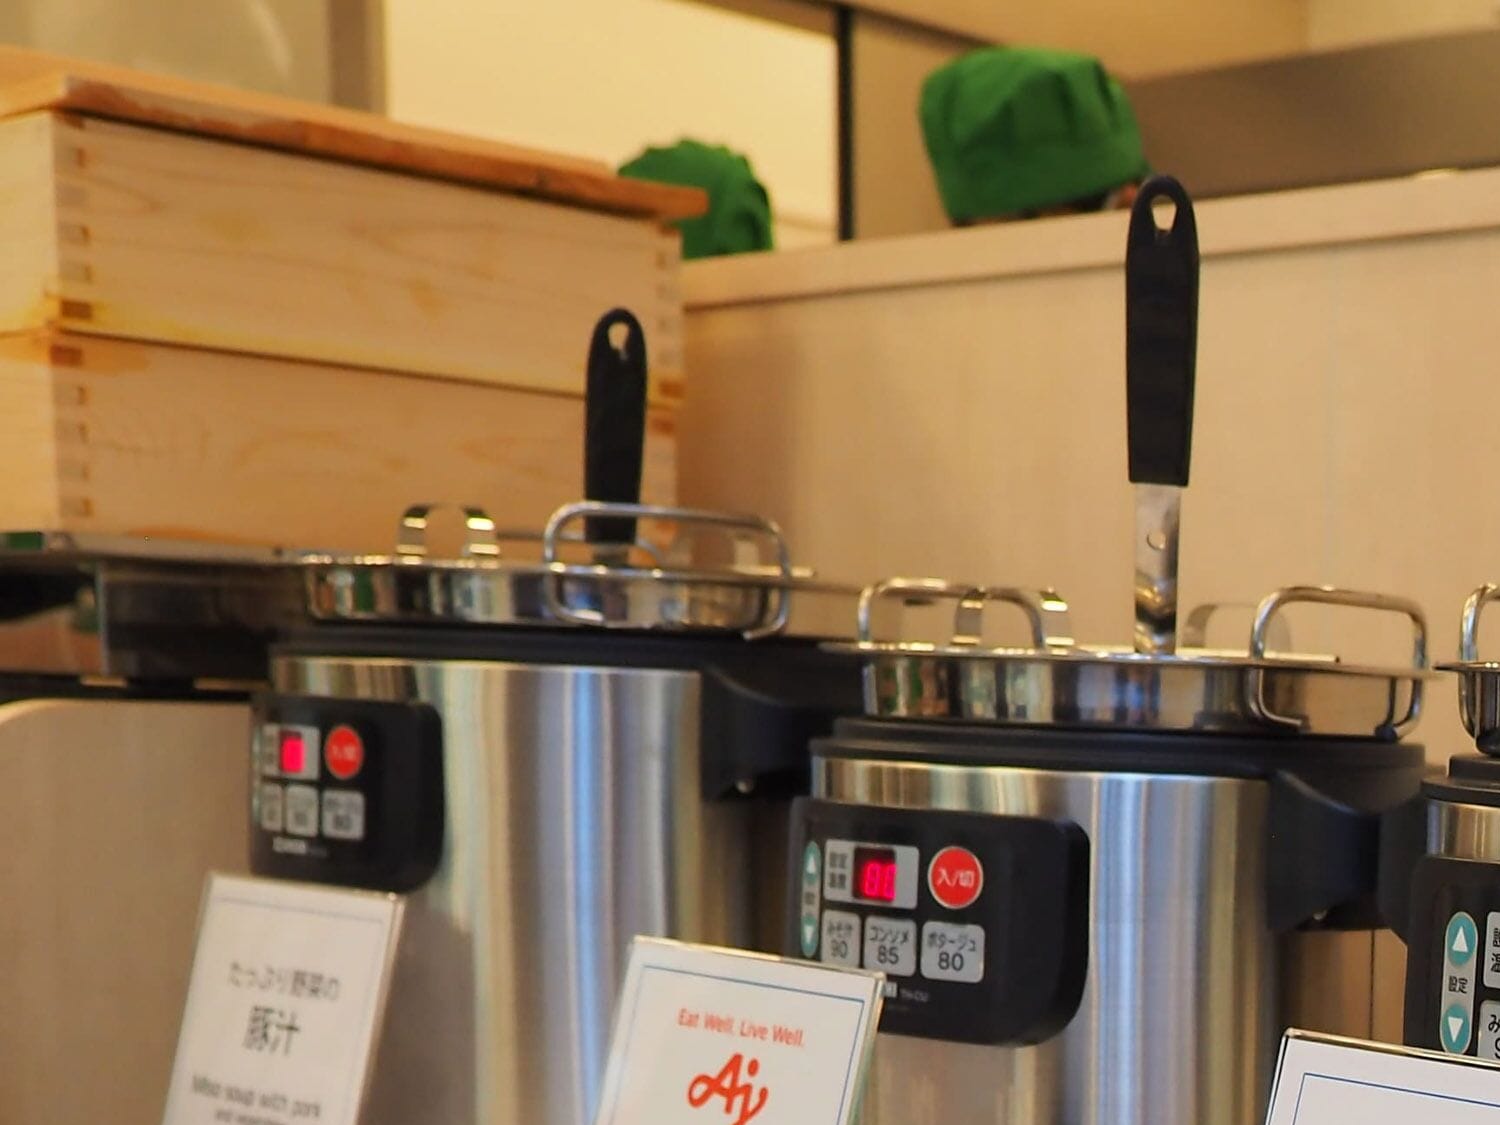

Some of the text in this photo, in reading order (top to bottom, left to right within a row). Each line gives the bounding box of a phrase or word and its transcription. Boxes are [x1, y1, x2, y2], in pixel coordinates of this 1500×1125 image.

[877, 945, 899, 965] 85
[938, 952, 965, 972] 80
[243, 1004, 302, 1056] 豚汁
[678, 1008, 700, 1028] Eat
[740, 1020, 769, 1041] Live
[773, 1025, 805, 1047] Well.
